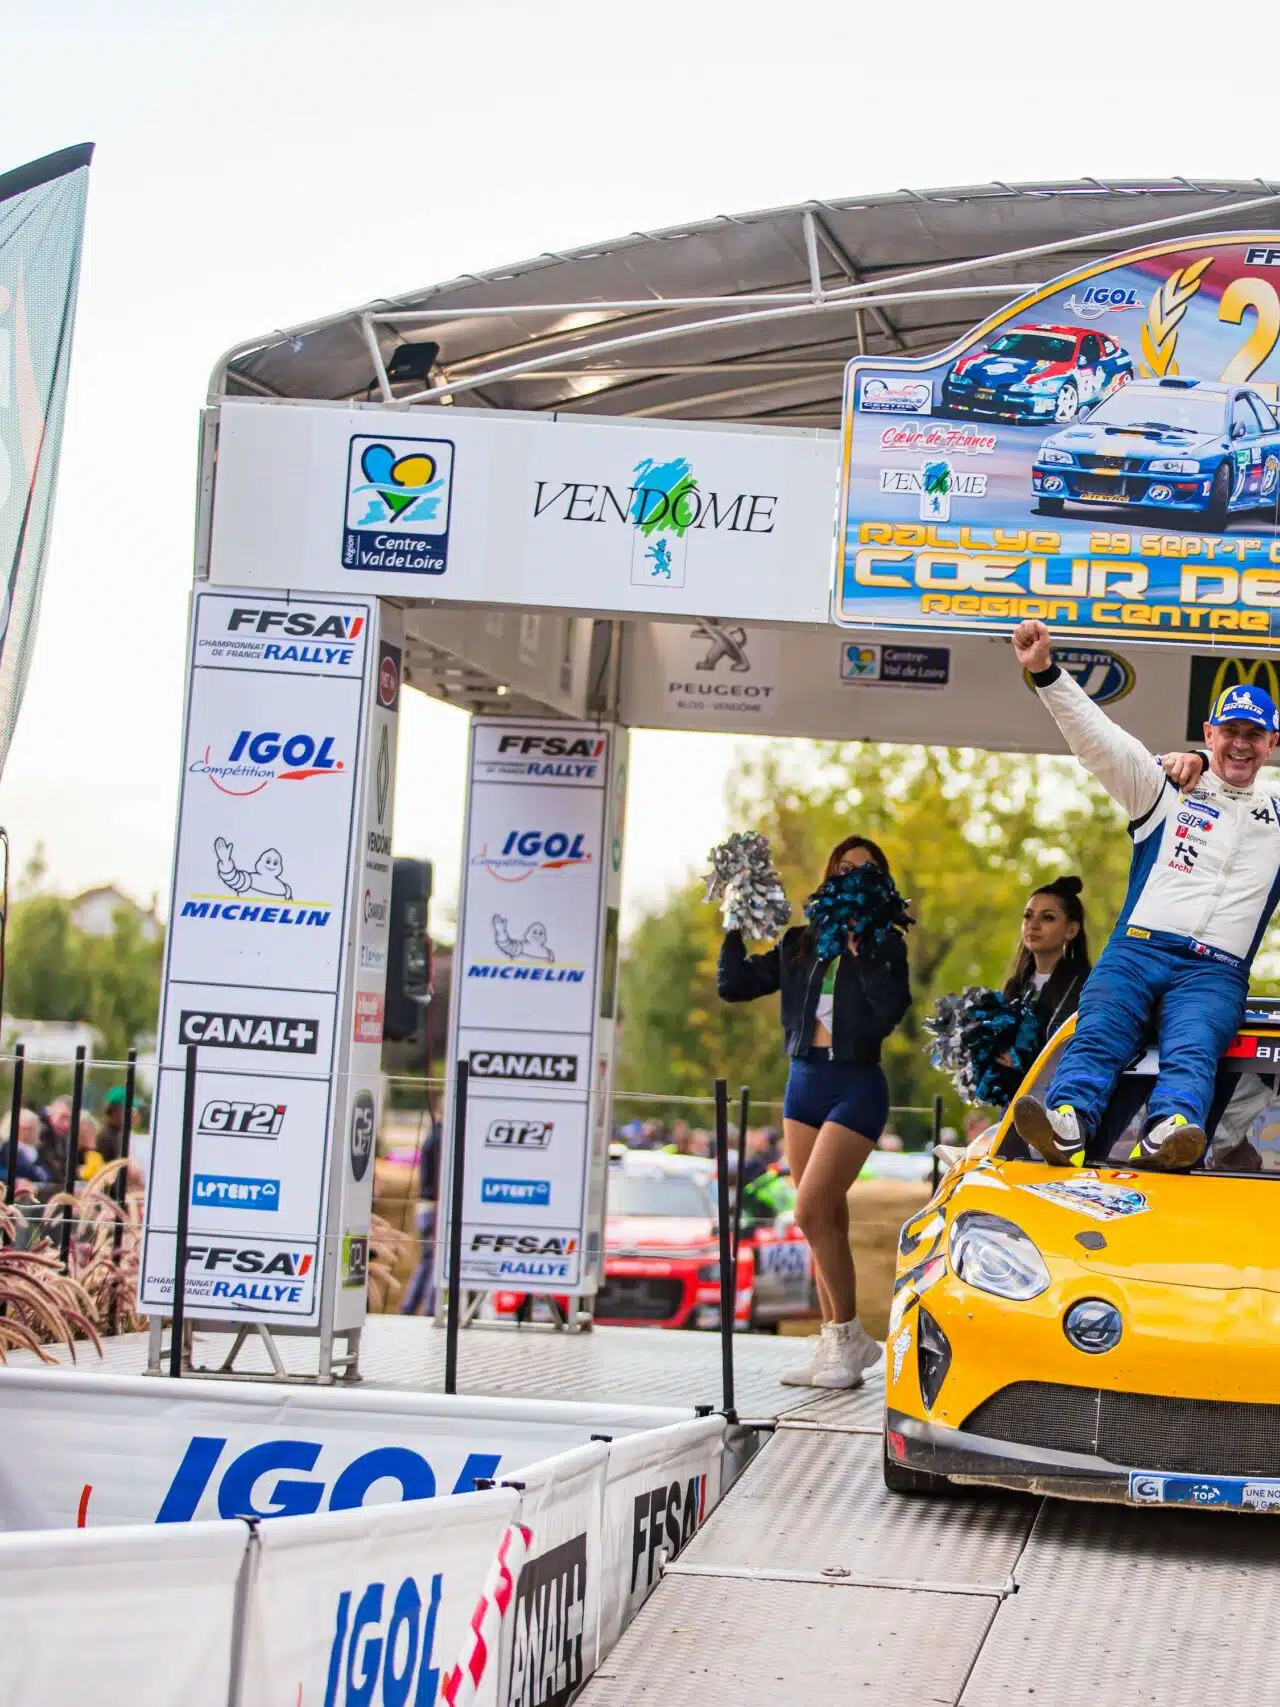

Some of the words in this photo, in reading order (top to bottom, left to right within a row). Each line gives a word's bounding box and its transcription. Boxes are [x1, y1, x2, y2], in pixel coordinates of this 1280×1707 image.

[1083, 287, 1137, 305] IGOL
[925, 431, 941, 445] de
[946, 431, 995, 448] France
[533, 480, 778, 533] VENDÔME
[344, 534, 357, 564] Région
[375, 535, 432, 551] Centre-
[859, 522, 1060, 554] RALLYE
[1089, 529, 1131, 555] 29
[405, 554, 444, 570] Loire
[920, 593, 1078, 621] REGION
[1091, 601, 1270, 631] CENTRE
[227, 608, 346, 639] FFSA
[198, 639, 266, 650] CHAMPIONNAT
[211, 648, 224, 657] DE
[226, 649, 264, 660] FRANCE
[263, 644, 354, 665] RALLYE
[668, 682, 774, 699] PEUGEOT
[228, 731, 336, 769] IGOL
[498, 735, 592, 757] FFSA
[189, 760, 275, 780] Compétition
[527, 762, 598, 778] RALLYE
[1177, 812, 1203, 827] elf
[502, 831, 586, 858] IGOL
[1168, 860, 1193, 875] Archi
[180, 901, 332, 927] MICHELIN
[467, 965, 585, 983] MICHELIN
[184, 1015, 314, 1048] CANAL+
[471, 1054, 574, 1079] CANAL+
[199, 1099, 288, 1135] GT2i
[485, 1119, 555, 1145] GT2i
[196, 1181, 262, 1200] LPTENT
[470, 1233, 564, 1255] FFSA
[500, 1260, 569, 1276] RALLYE
[147, 1275, 214, 1288] CHAMONNAT
[160, 1285, 173, 1295] DE
[212, 1281, 303, 1302] RALLYE
[1192, 1491, 1214, 1500] TOP
[1246, 1489, 1266, 1498] UNE
[631, 1477, 699, 1595] FFSA
[325, 1573, 444, 1707] IGOL
[508, 1562, 584, 1707] ANAL+
